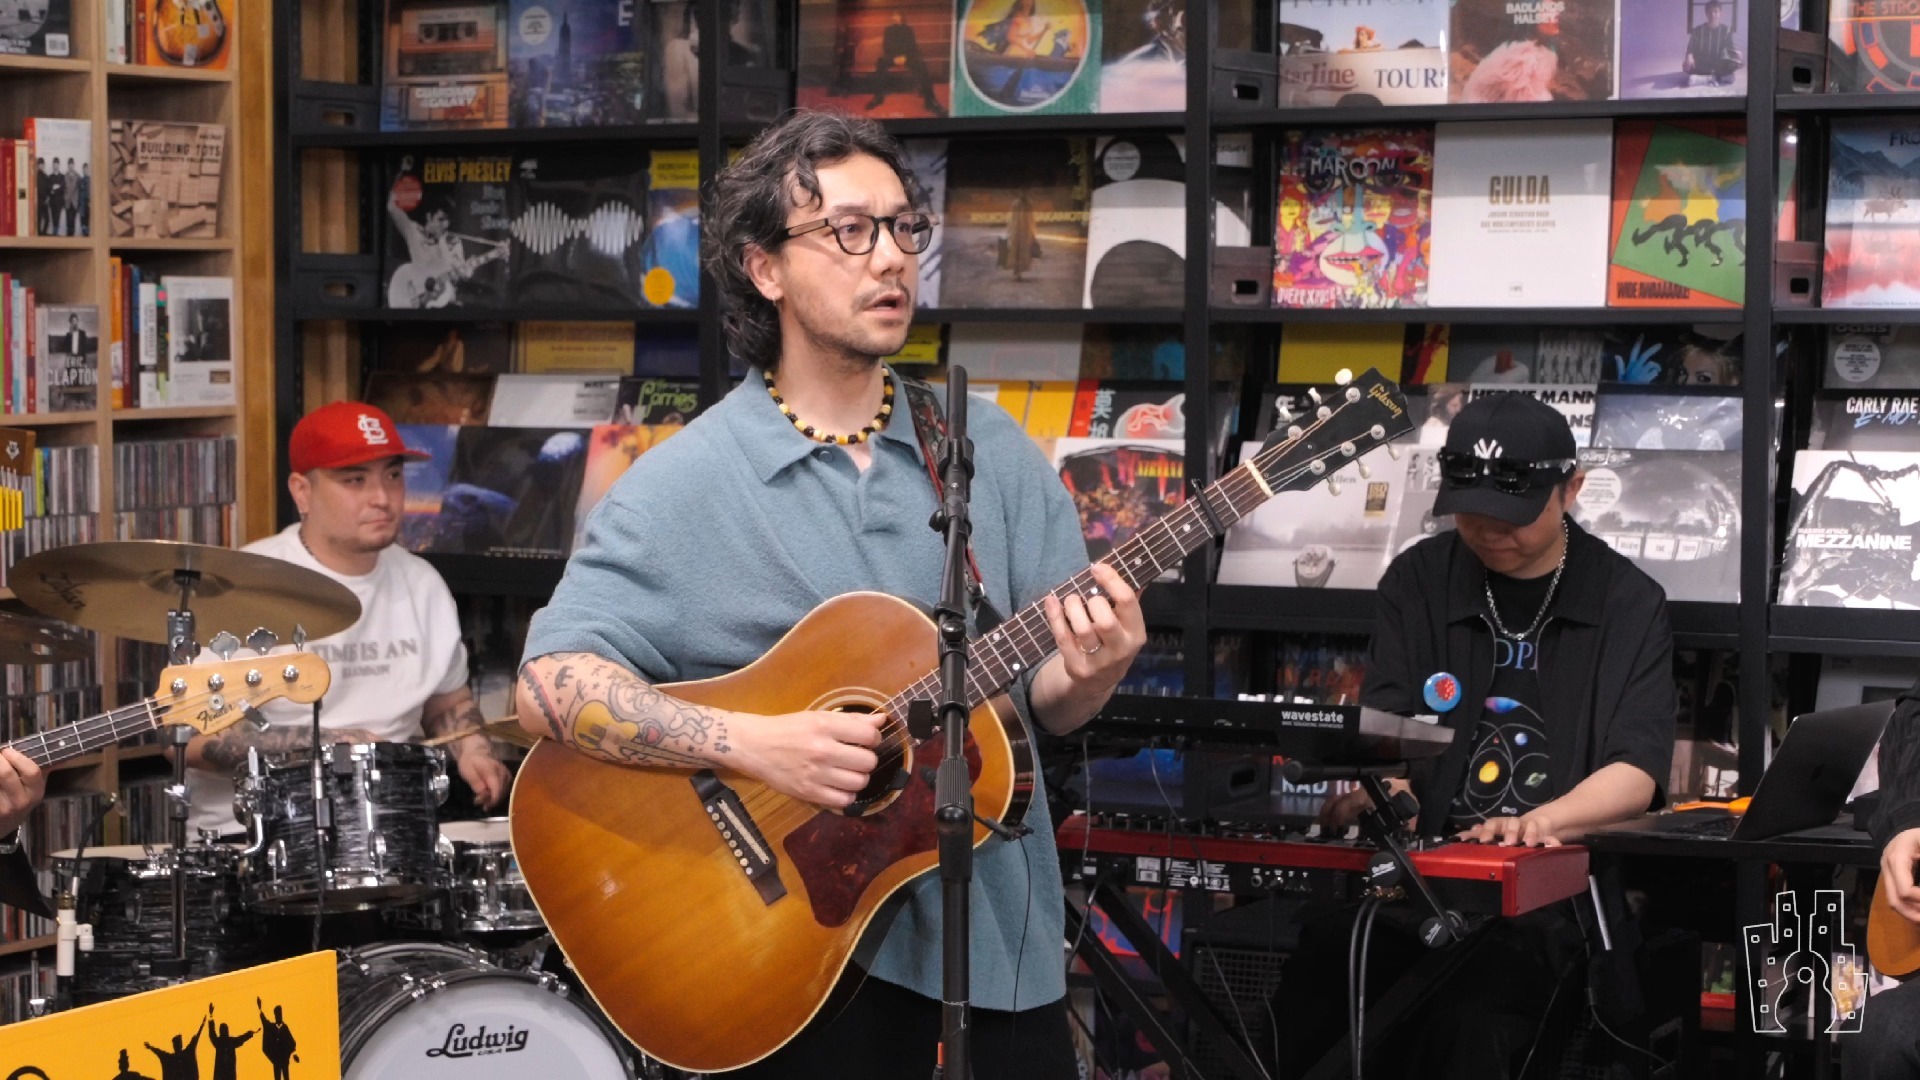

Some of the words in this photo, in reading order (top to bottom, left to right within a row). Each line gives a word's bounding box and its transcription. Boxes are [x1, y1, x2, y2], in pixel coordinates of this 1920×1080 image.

[1506, 1, 1565, 14] BADLANDS
[1514, 13, 1559, 24] HALSEY
[140, 142, 190, 155] BUILDING
[196, 144, 220, 157] TOYS
[424, 162, 457, 183] ELVIS
[460, 161, 511, 182] PRESLEY
[1490, 175, 1550, 206] GULDA
[66, 356, 84, 368] ERIC
[48, 367, 98, 386] CLAPTON
[1367, 383, 1403, 419] Gibson
[1846, 397, 1888, 413] CARLY
[1891, 398, 1919, 413] RAE
[1796, 534, 1912, 550] MEZZANINE
[361, 642, 379, 660] IS
[385, 638, 418, 658] AN
[1494, 637, 1539, 670] DP
[197, 703, 233, 731] Fender
[1281, 710, 1344, 723] wavestate
[426, 1023, 529, 1058] Ludwig
